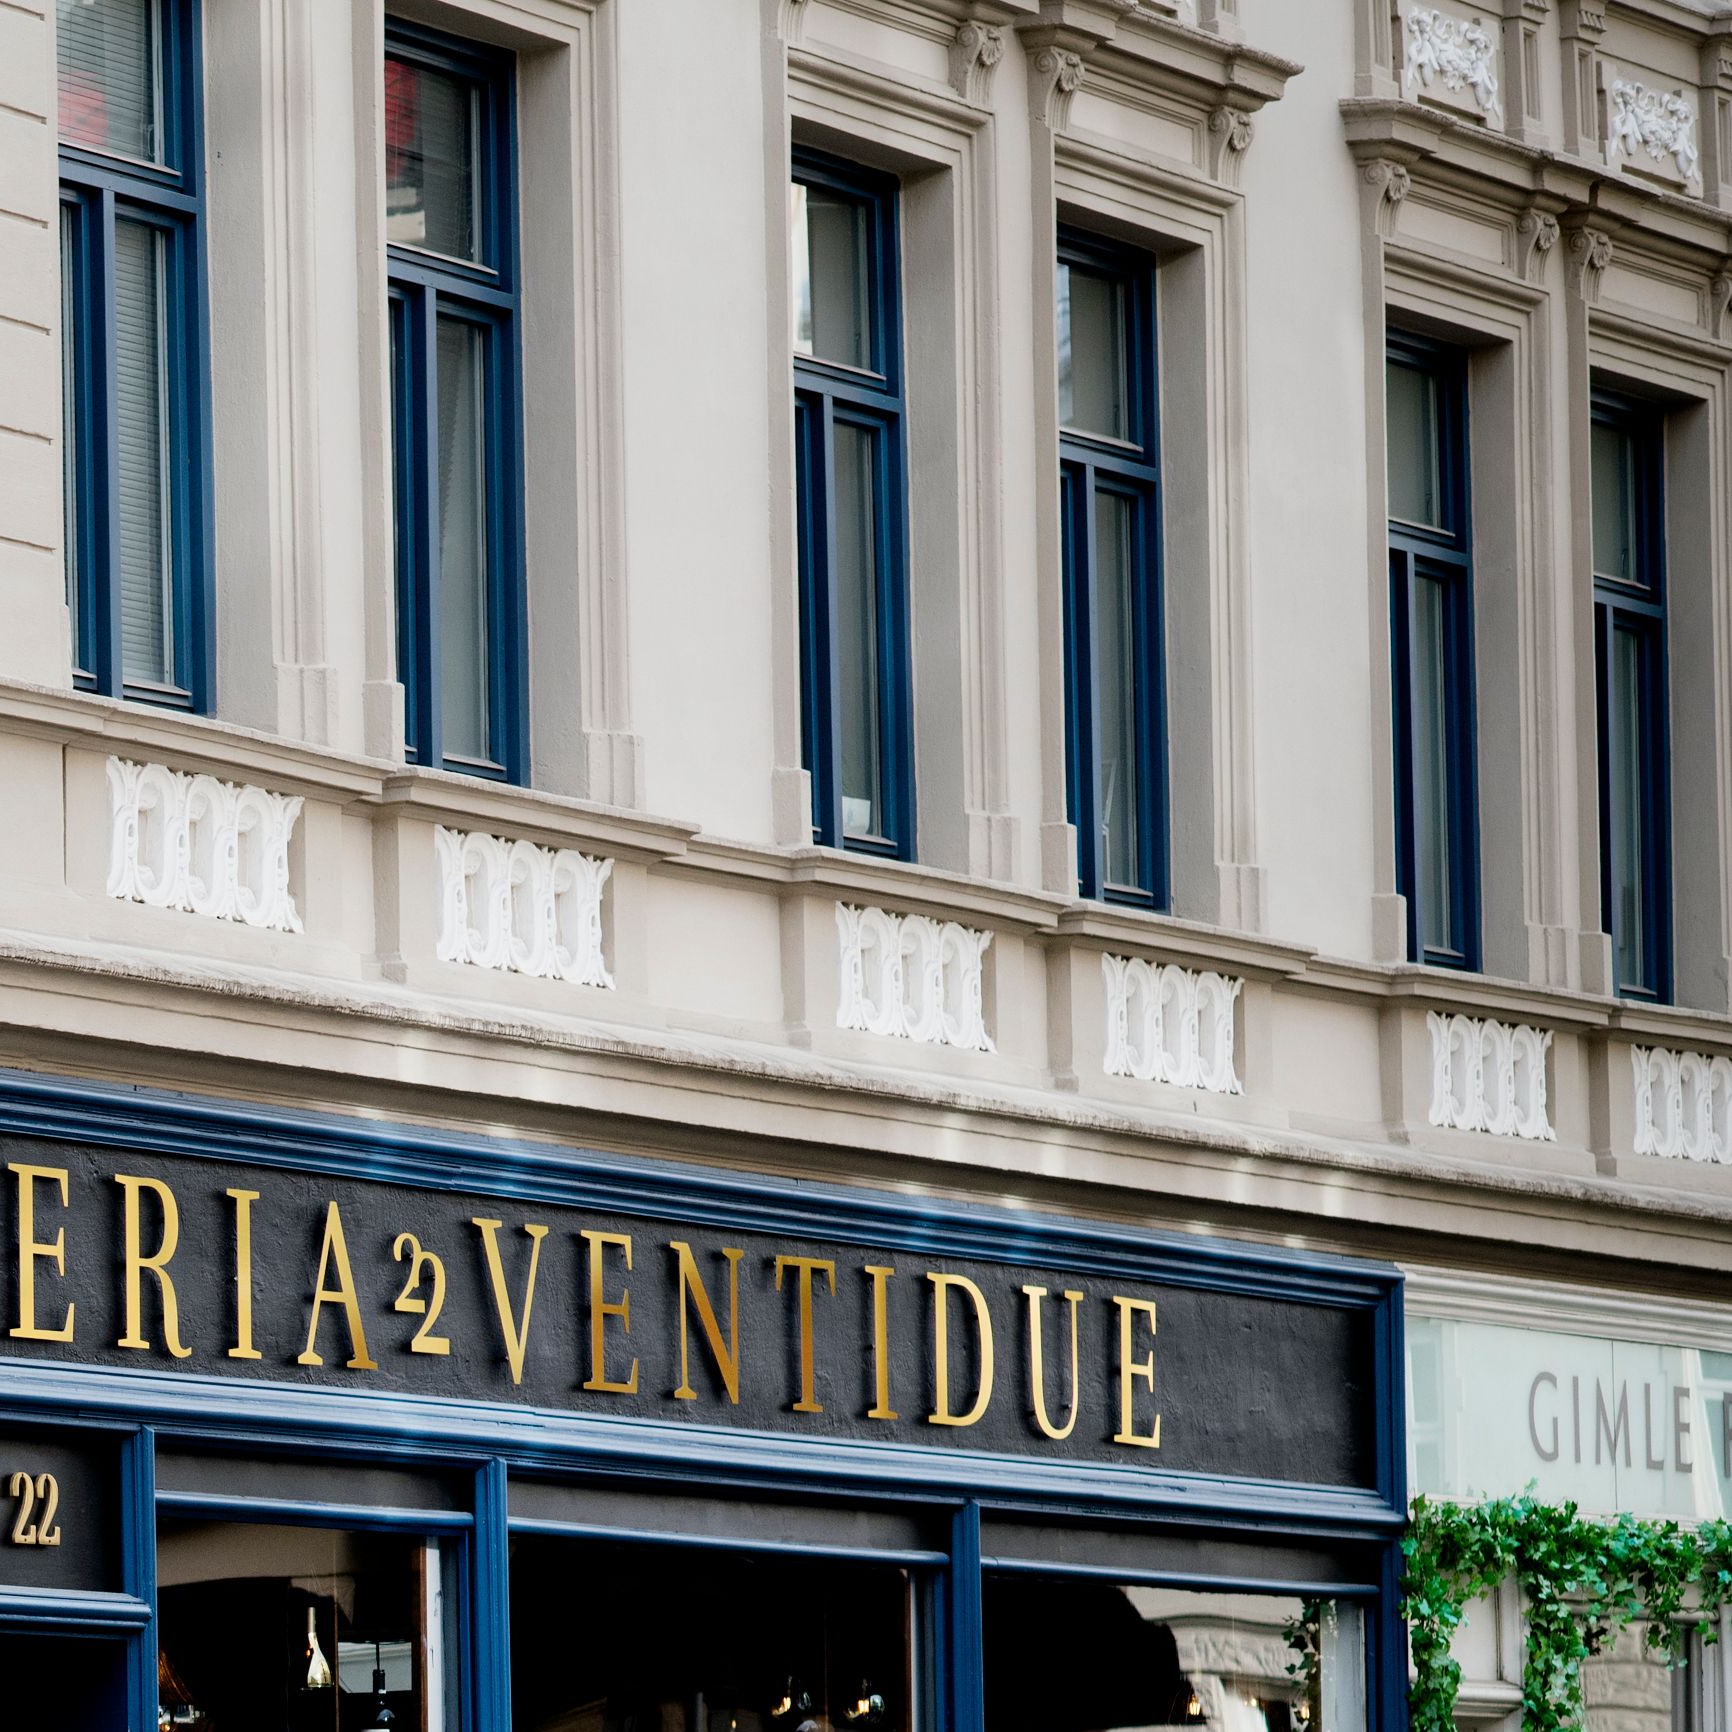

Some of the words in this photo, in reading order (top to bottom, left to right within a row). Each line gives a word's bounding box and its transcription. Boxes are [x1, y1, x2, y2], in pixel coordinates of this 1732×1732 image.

[392, 1231, 452, 1356] 22
[471, 1216, 1162, 1449] VENTIDUE
[1528, 1371, 1693, 1474] GIMLE
[8, 1471, 61, 1546] 22
